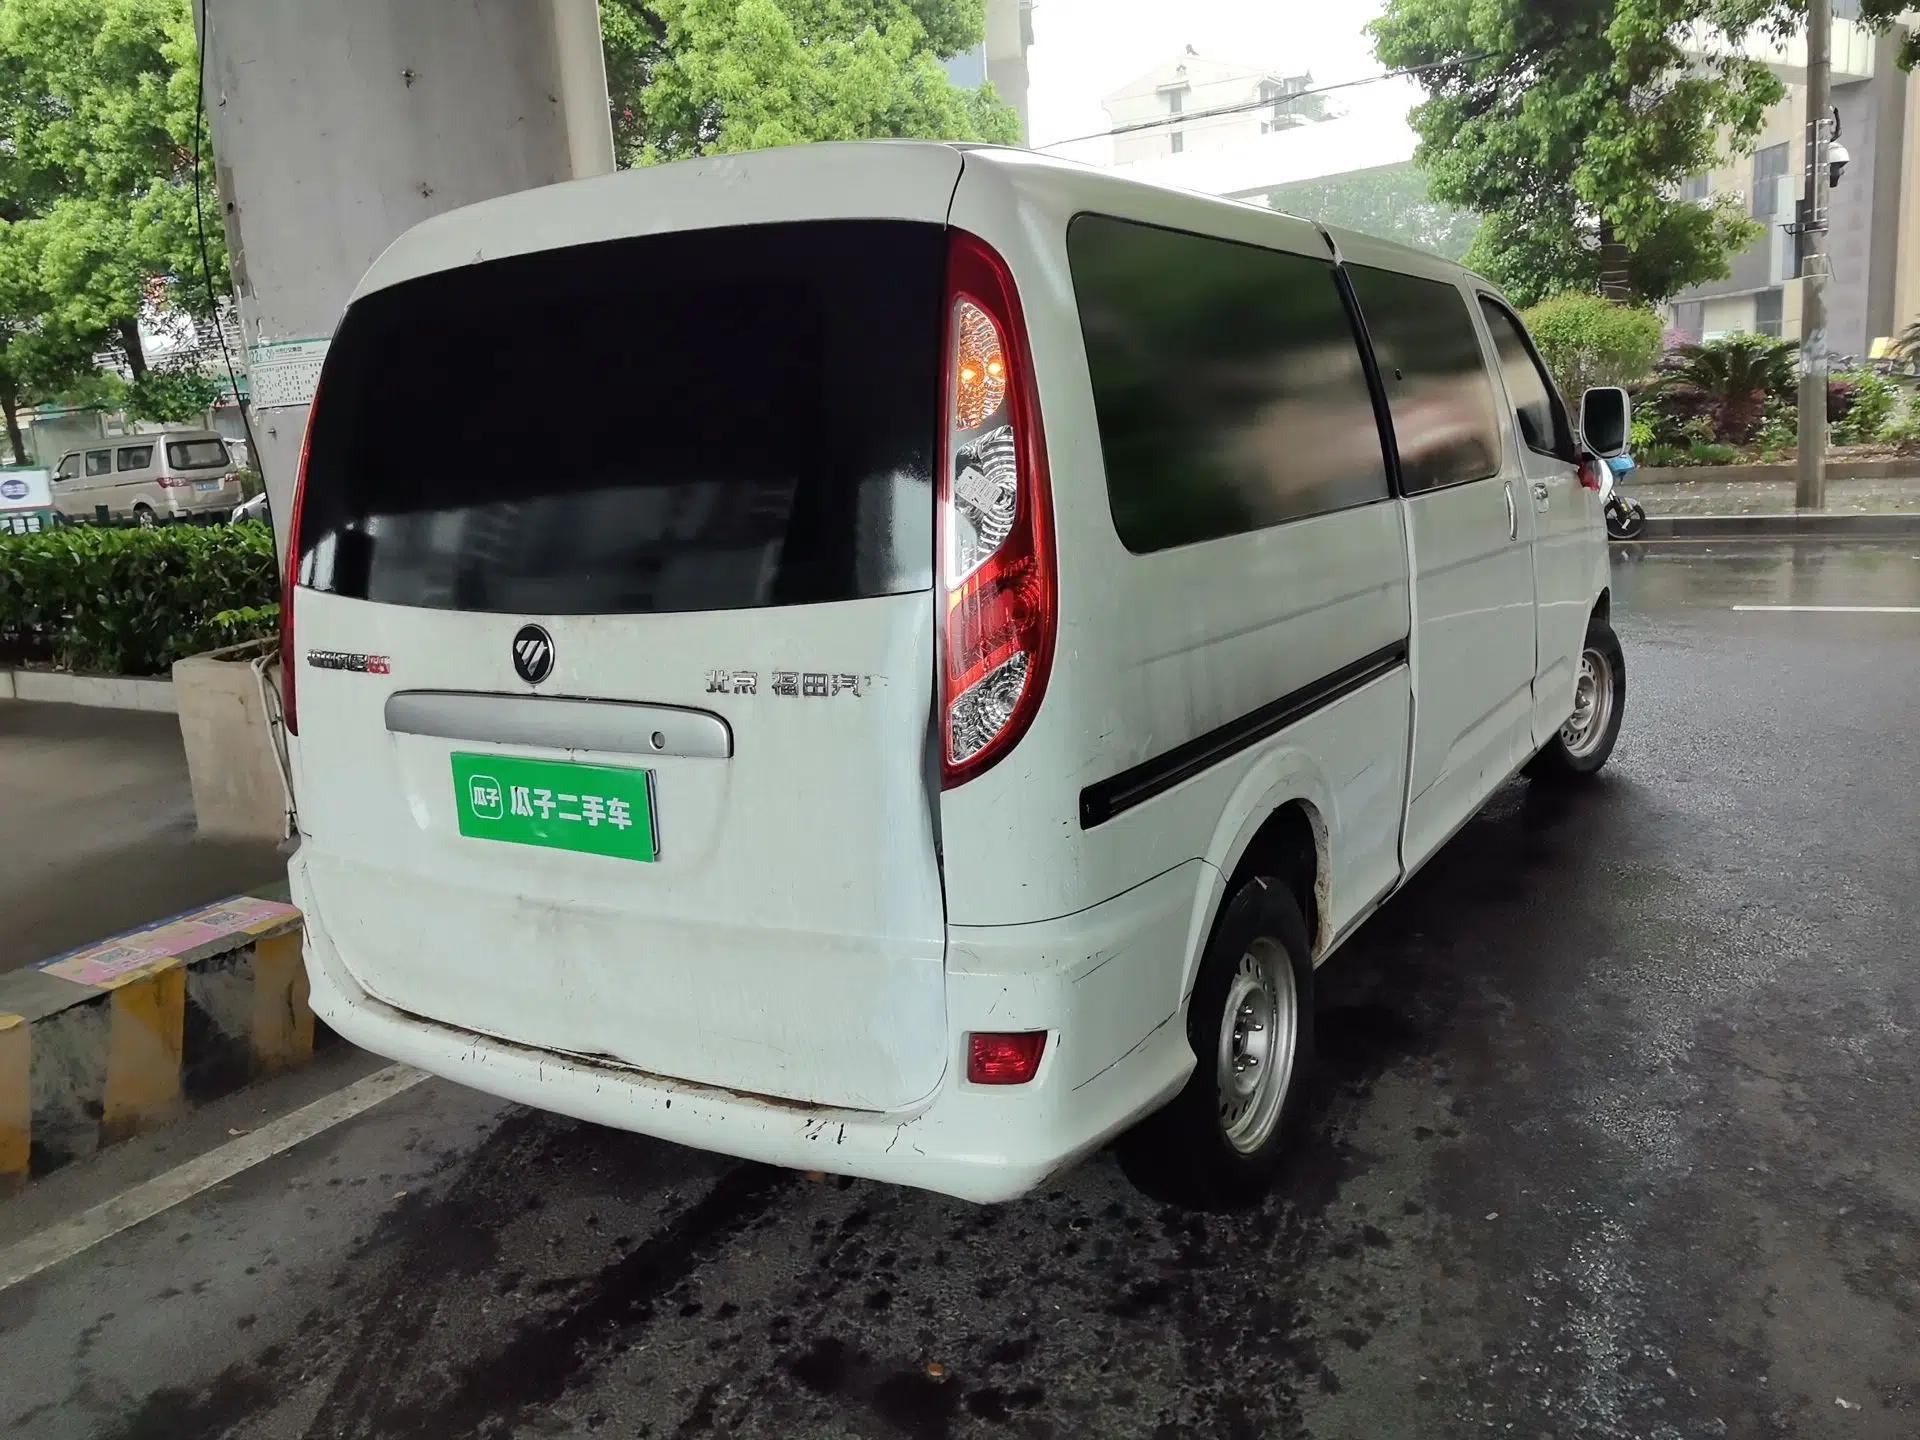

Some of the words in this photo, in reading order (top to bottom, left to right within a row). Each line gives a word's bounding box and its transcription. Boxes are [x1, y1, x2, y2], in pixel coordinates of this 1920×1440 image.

[705, 670, 758, 695] 北京
[771, 671, 888, 698] 福田汽
[473, 786, 500, 808] 瓜子
[510, 785, 633, 830] 瓜子二手车
